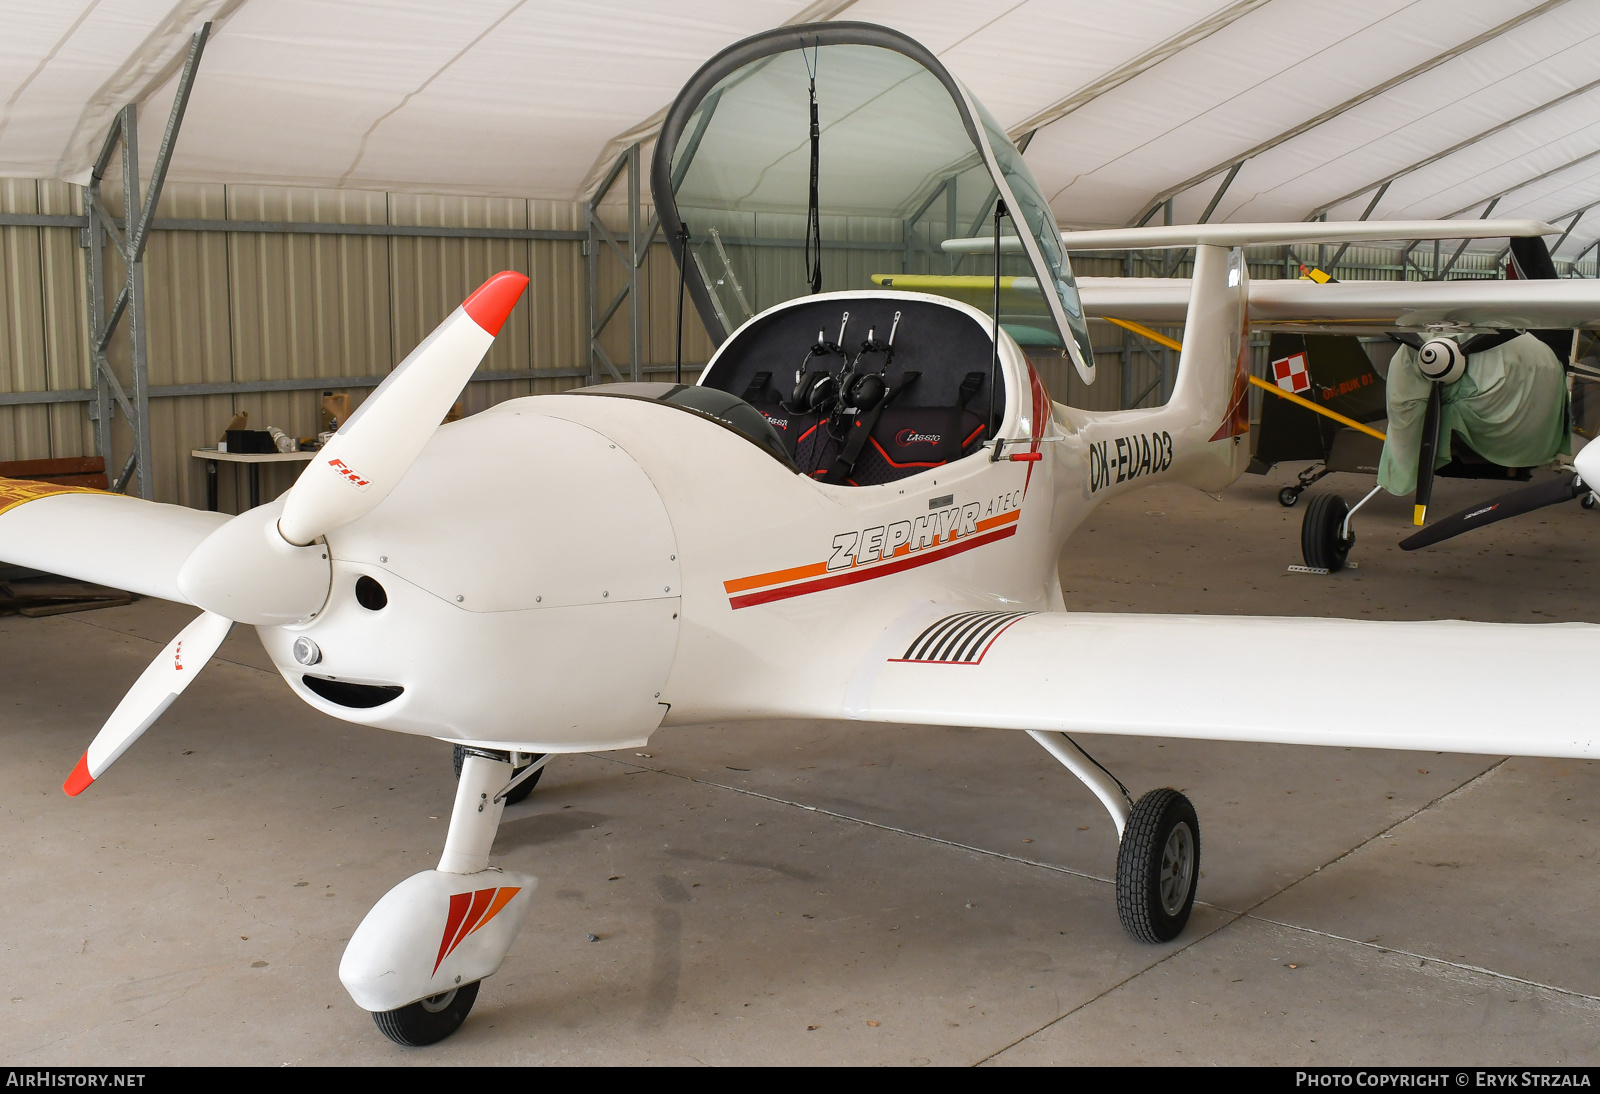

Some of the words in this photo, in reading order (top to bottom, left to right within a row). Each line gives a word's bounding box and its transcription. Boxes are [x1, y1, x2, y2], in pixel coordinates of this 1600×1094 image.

[1361, 373, 1374, 386] 01
[895, 428, 941, 447] CLASSIC
[1090, 431, 1172, 493] OK-EUA03
[985, 490, 1020, 516] ATEC
[827, 502, 980, 571] ZEPHYR
